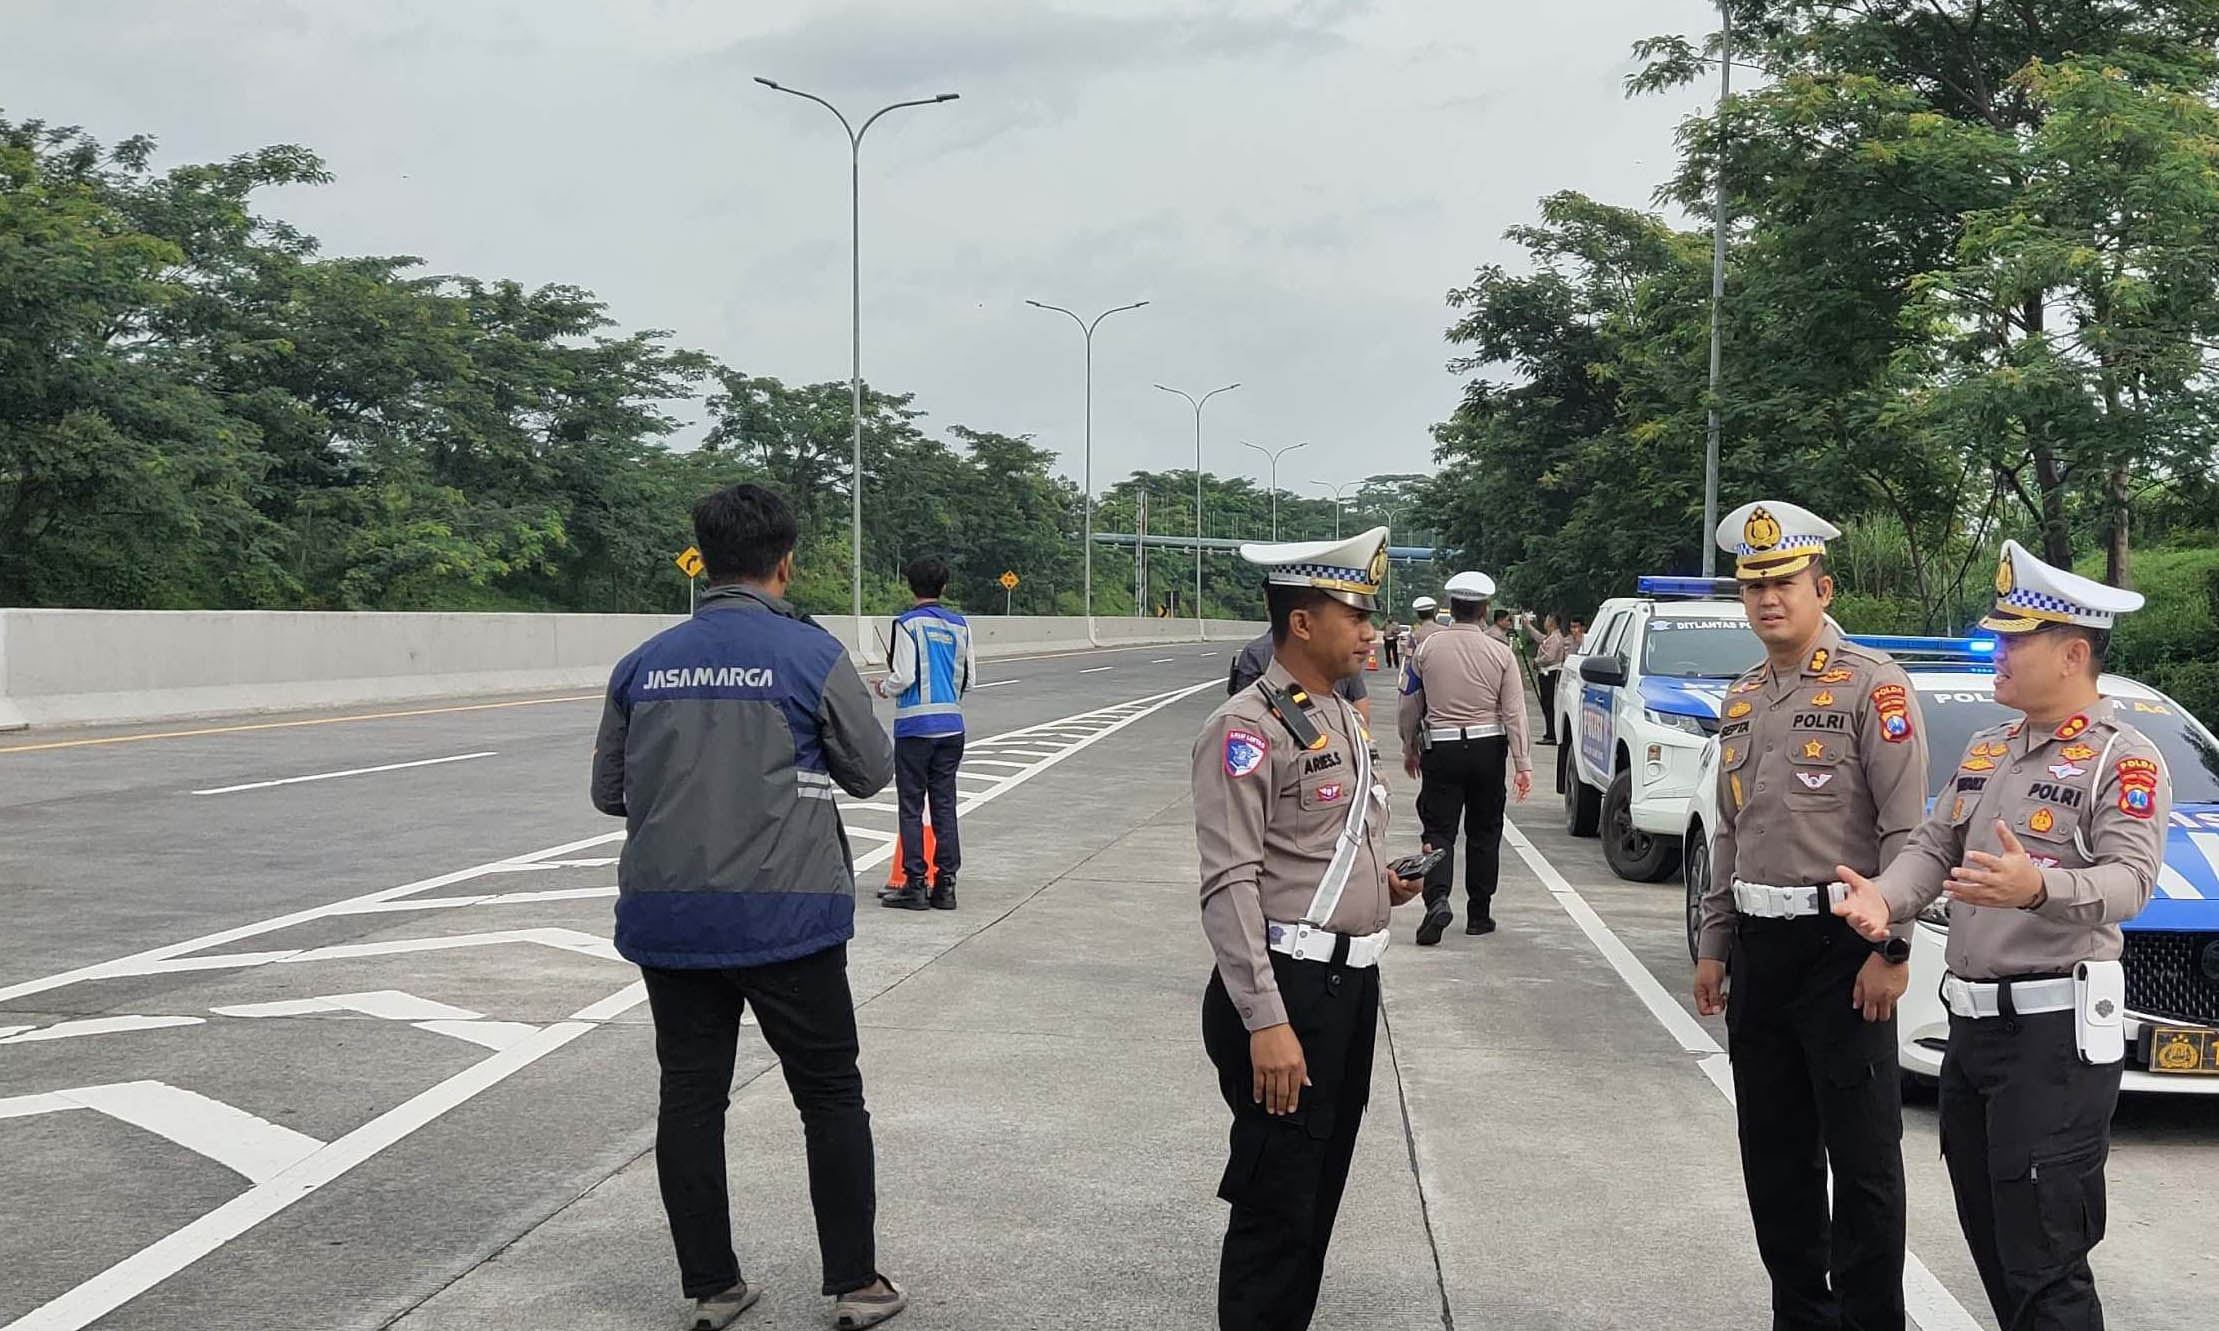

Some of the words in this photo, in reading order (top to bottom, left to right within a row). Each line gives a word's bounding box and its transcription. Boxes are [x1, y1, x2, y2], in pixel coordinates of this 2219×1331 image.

[1677, 621, 1737, 630] DITLANTAS
[643, 667, 773, 690] JASAMARGA
[1792, 713, 1845, 729] POLRI
[2119, 759, 2156, 772] POLDA
[2027, 783, 2082, 808] POLRI
